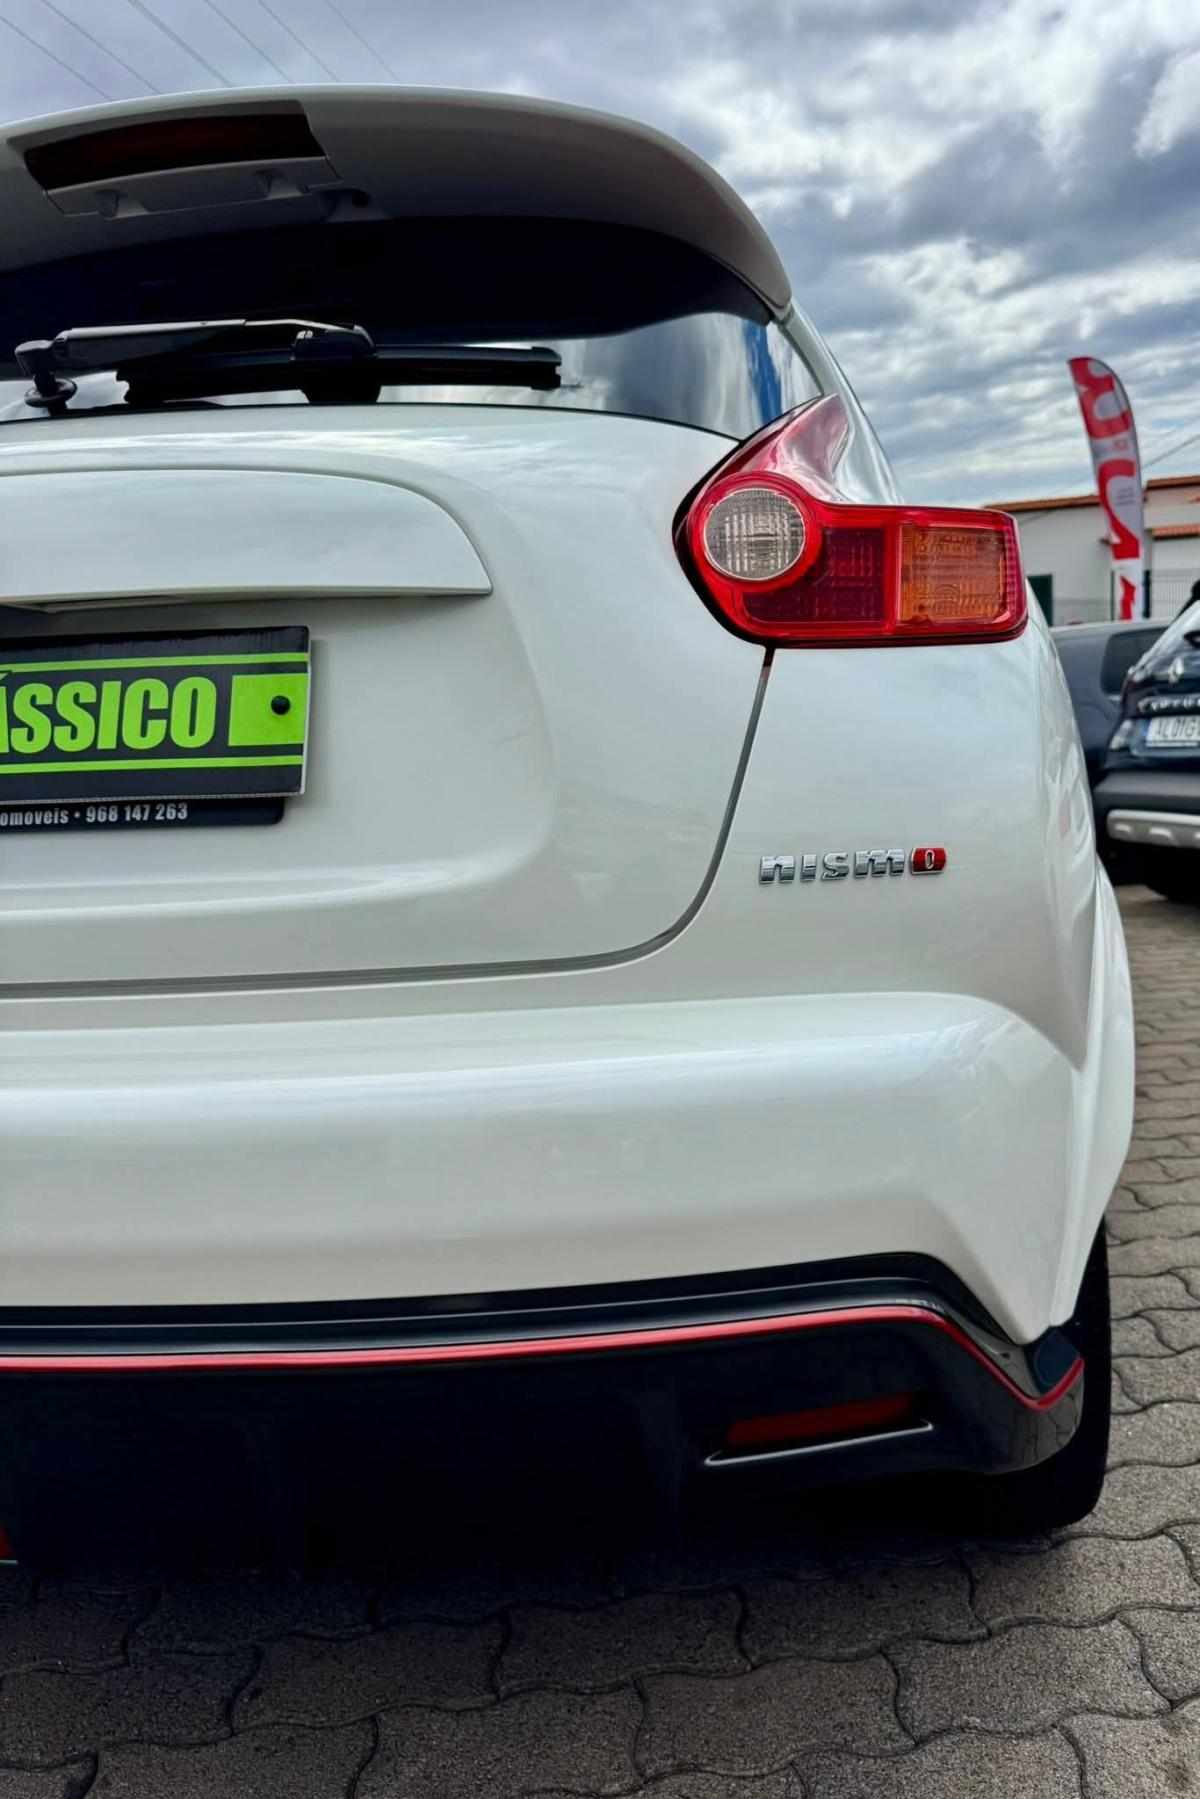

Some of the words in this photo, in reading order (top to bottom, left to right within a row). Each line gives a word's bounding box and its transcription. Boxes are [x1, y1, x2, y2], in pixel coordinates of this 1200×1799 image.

[0, 673, 217, 754] SSICO
[86, 805, 118, 823] 968
[124, 804, 150, 821] 147
[155, 802, 188, 820] 263
